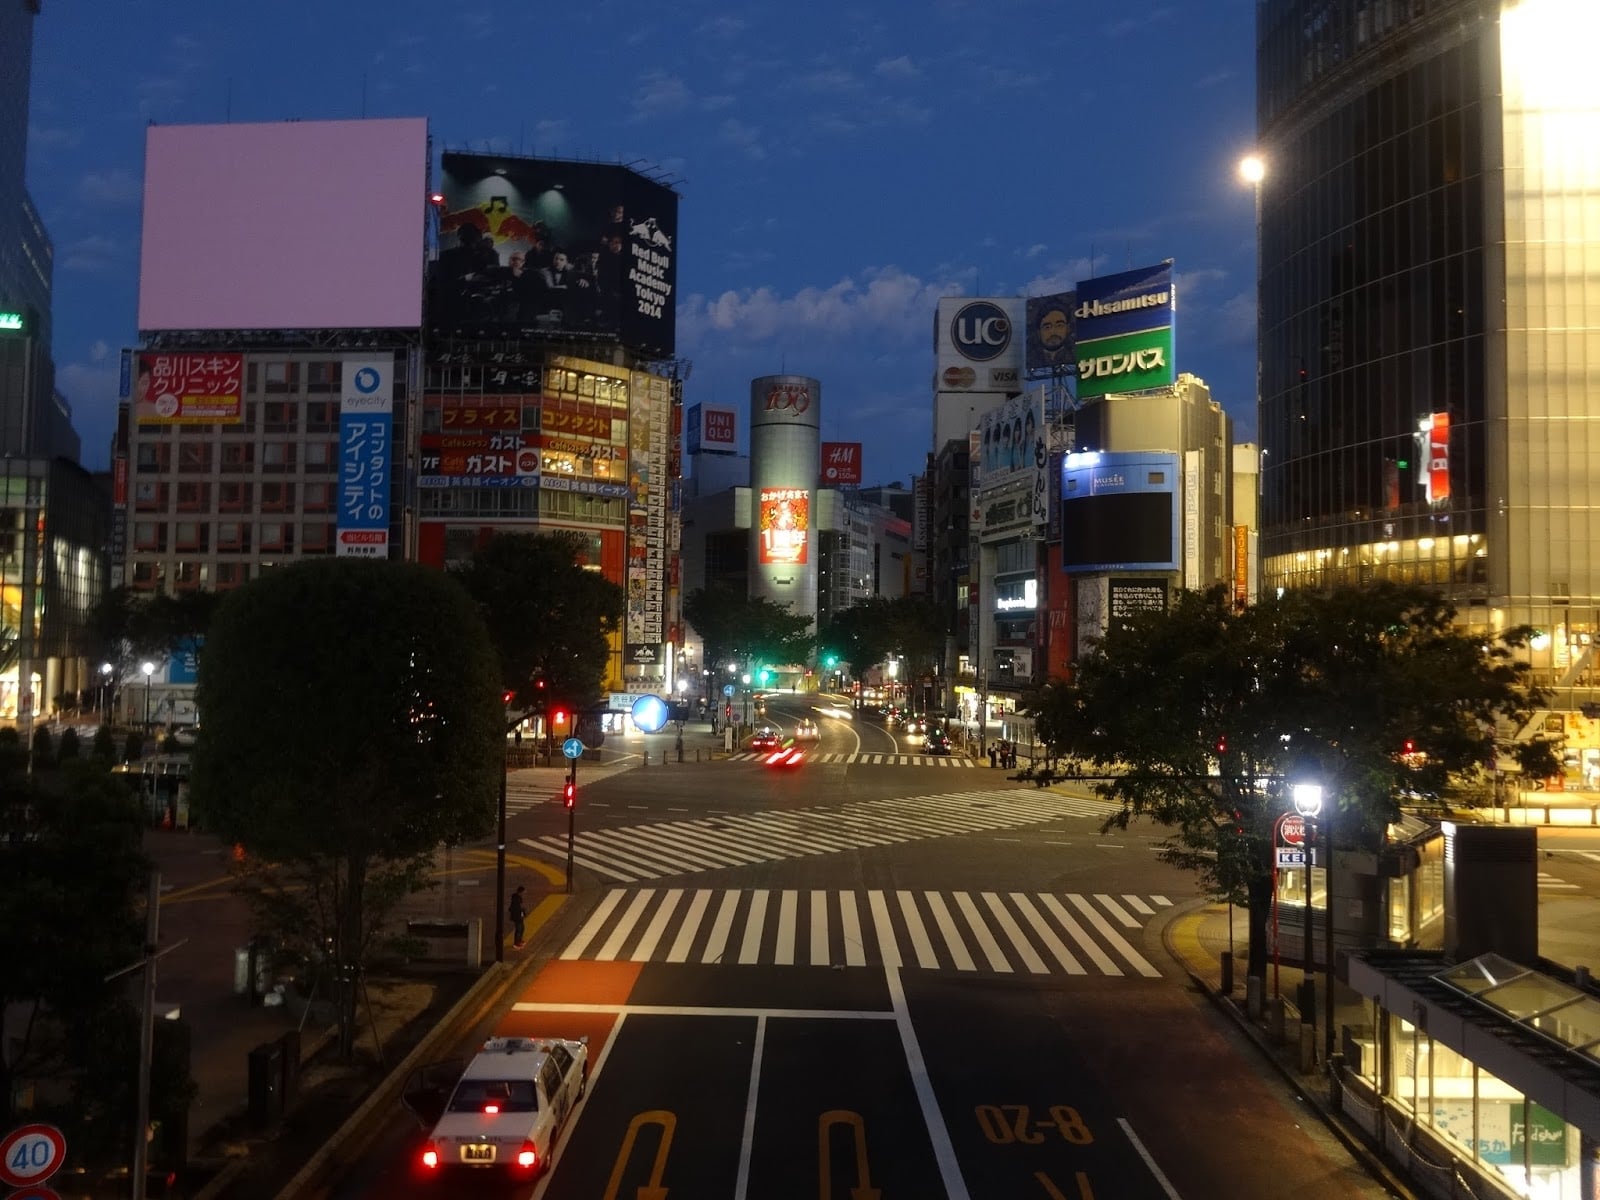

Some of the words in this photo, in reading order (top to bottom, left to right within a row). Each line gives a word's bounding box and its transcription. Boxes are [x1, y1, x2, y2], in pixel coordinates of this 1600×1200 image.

[631, 243, 650, 261] Red
[650, 250, 669, 269] Bull
[637, 257, 664, 280] Music
[628, 268, 671, 296] Academy
[634, 283, 665, 306] Tokyo
[1074, 292, 1168, 318] Hisamitsu
[637, 300, 662, 319] 2014
[153, 357, 239, 377] 品川スキン
[1078, 347, 1165, 380] サロンパス
[153, 376, 239, 395] クリニック
[992, 371, 1018, 382] VISA
[346, 397, 387, 408] eyecity
[762, 391, 809, 417] 109
[542, 410, 608, 434] コンタクト
[708, 414, 730, 426] UNI
[488, 436, 526, 450] ガスト
[708, 427, 732, 440] QLO
[422, 457, 440, 469] 7F
[465, 454, 511, 474] ガスト
[589, 445, 620, 461] ガスト
[829, 447, 854, 464] H&M
[345, 423, 366, 520] アイシティ
[369, 423, 385, 520] コンタクトの
[1033, 437, 1047, 521] もんじゃ
[975, 1105, 1095, 1144] 8-20
[12, 1141, 49, 1169] 40
